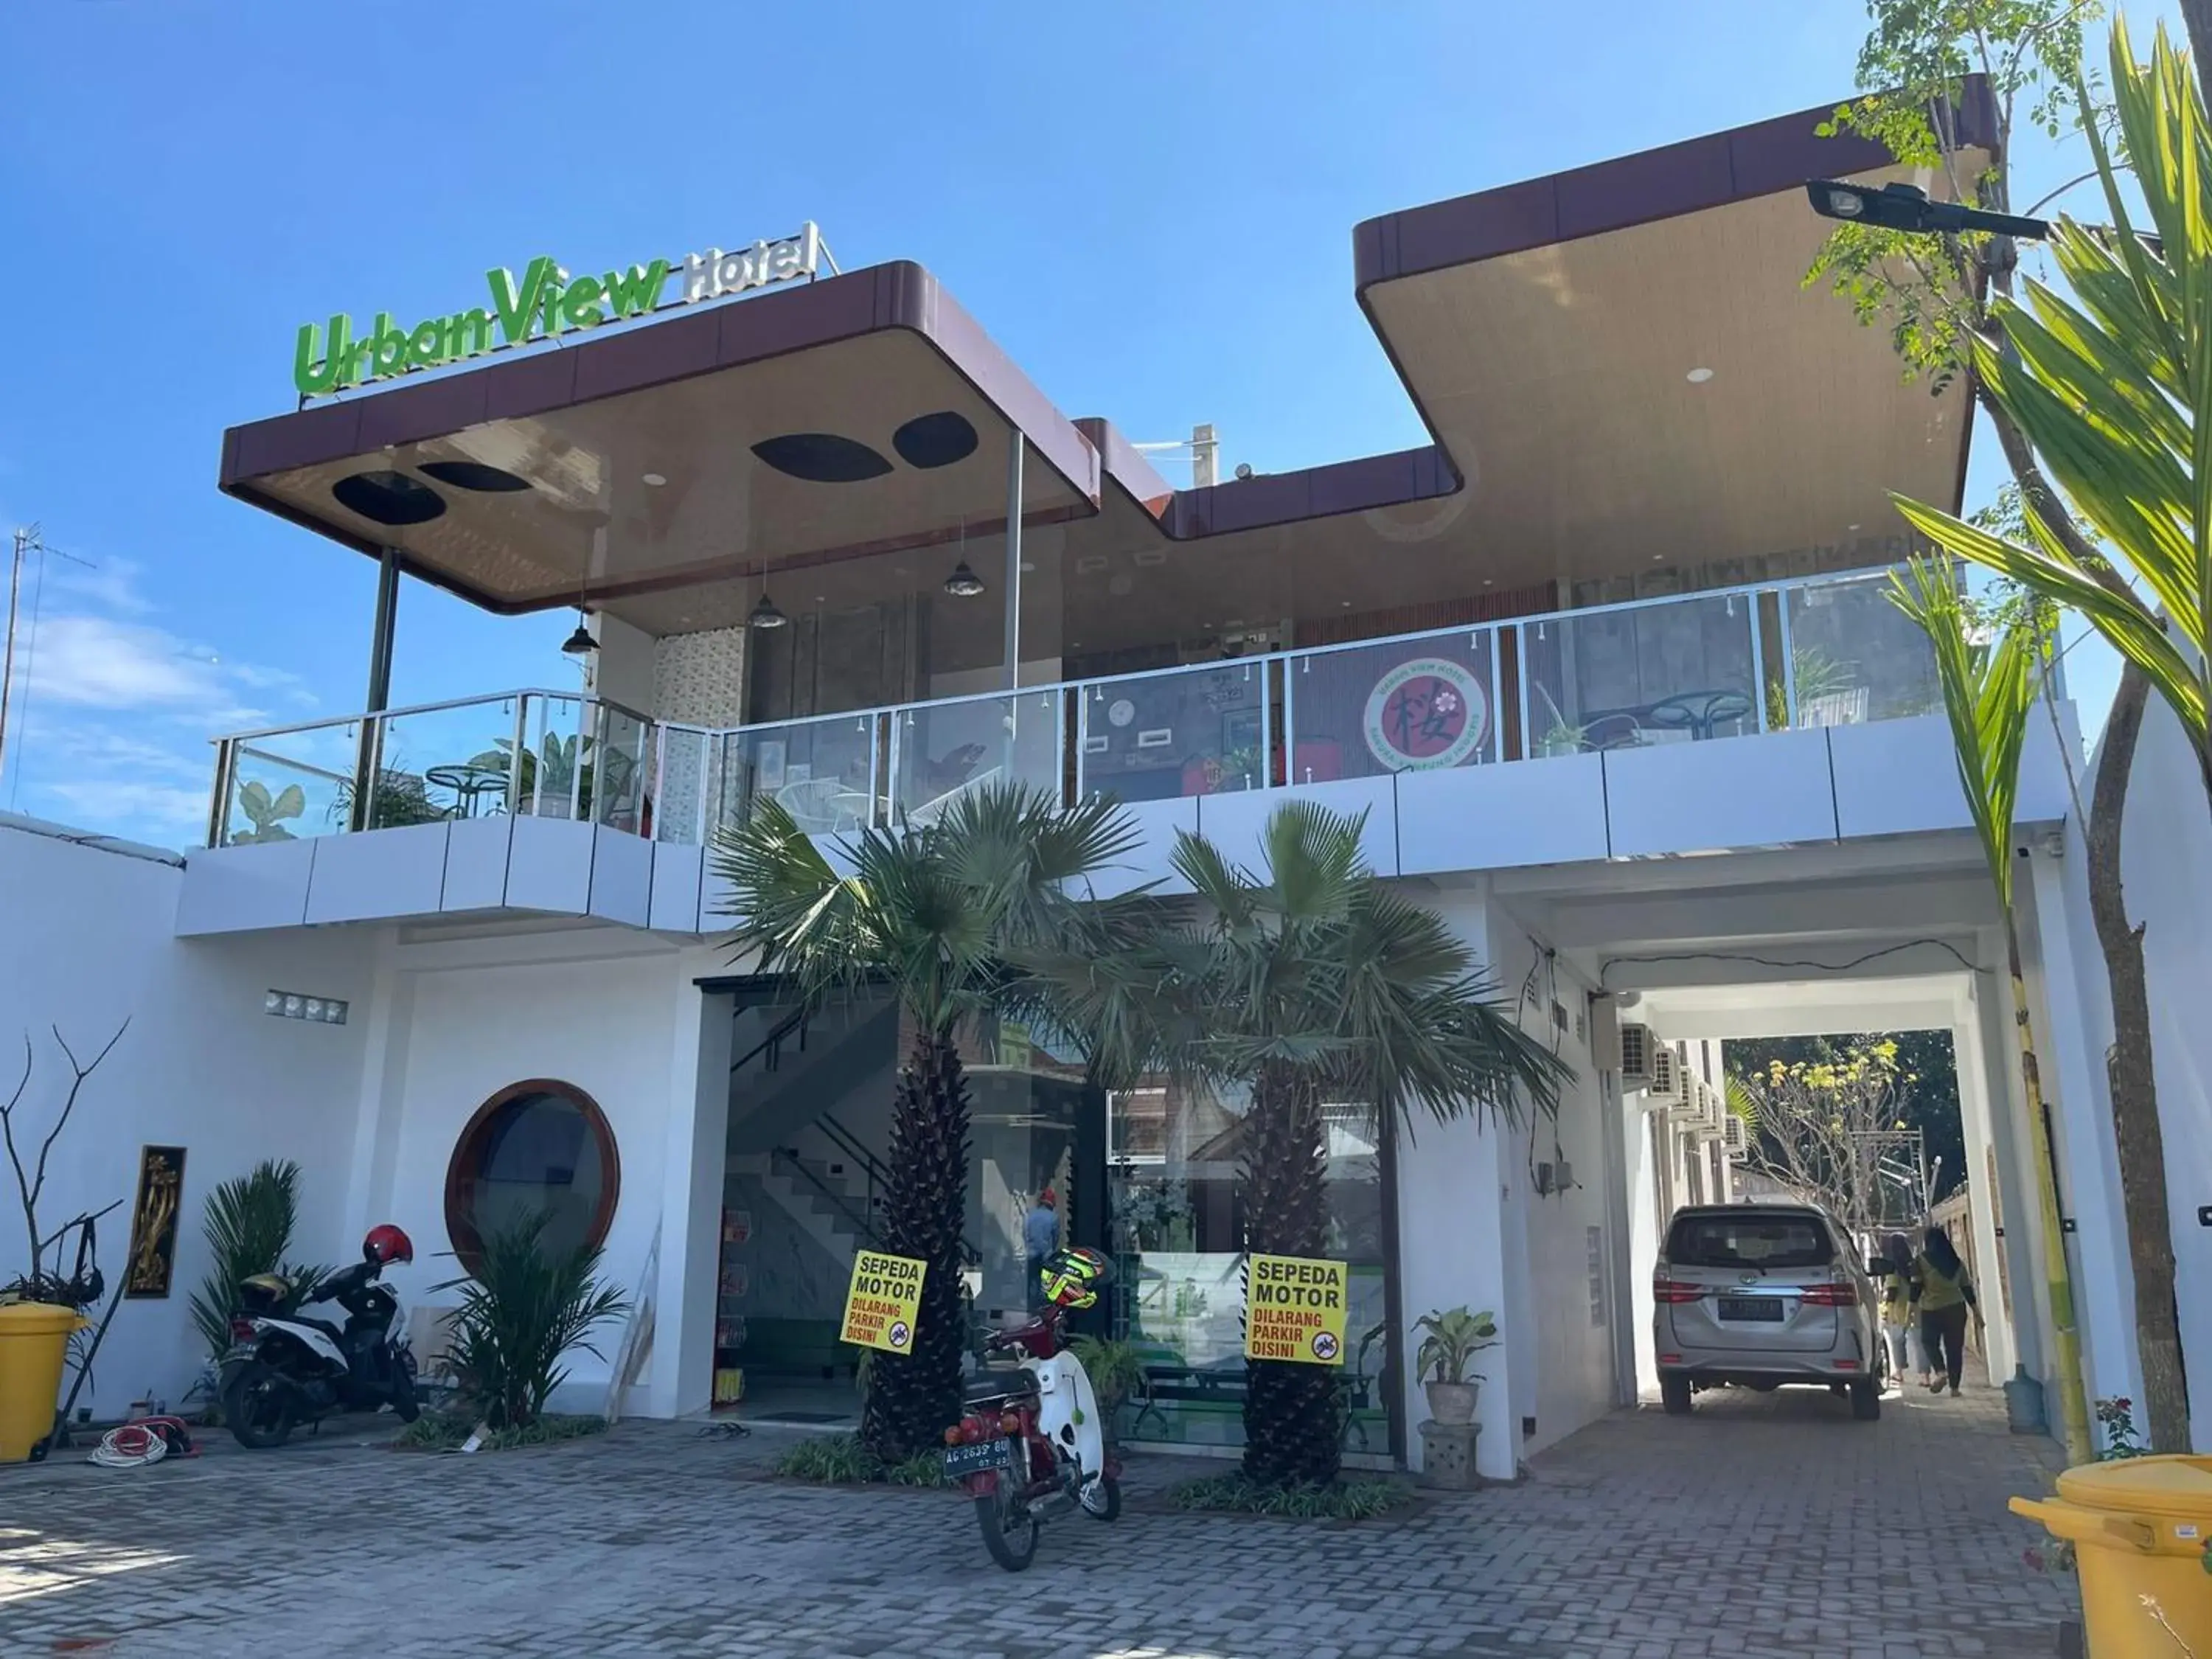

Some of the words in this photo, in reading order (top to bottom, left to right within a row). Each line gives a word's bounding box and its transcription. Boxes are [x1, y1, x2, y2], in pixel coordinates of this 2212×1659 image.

[682, 220, 819, 303] Hotel
[860, 1256, 919, 1281] SEPEDA
[1256, 1262, 1340, 1287] SEPEDA
[856, 1276, 916, 1301] MOTOR
[1256, 1284, 1339, 1308] MOTOR
[852, 1297, 901, 1318] DILARANG
[1253, 1308, 1322, 1327] DILARANG
[849, 1312, 886, 1329] PARKIR
[846, 1326, 877, 1343] DISINI
[1253, 1325, 1303, 1342] PARKIR
[1252, 1341, 1295, 1357] DISINI
